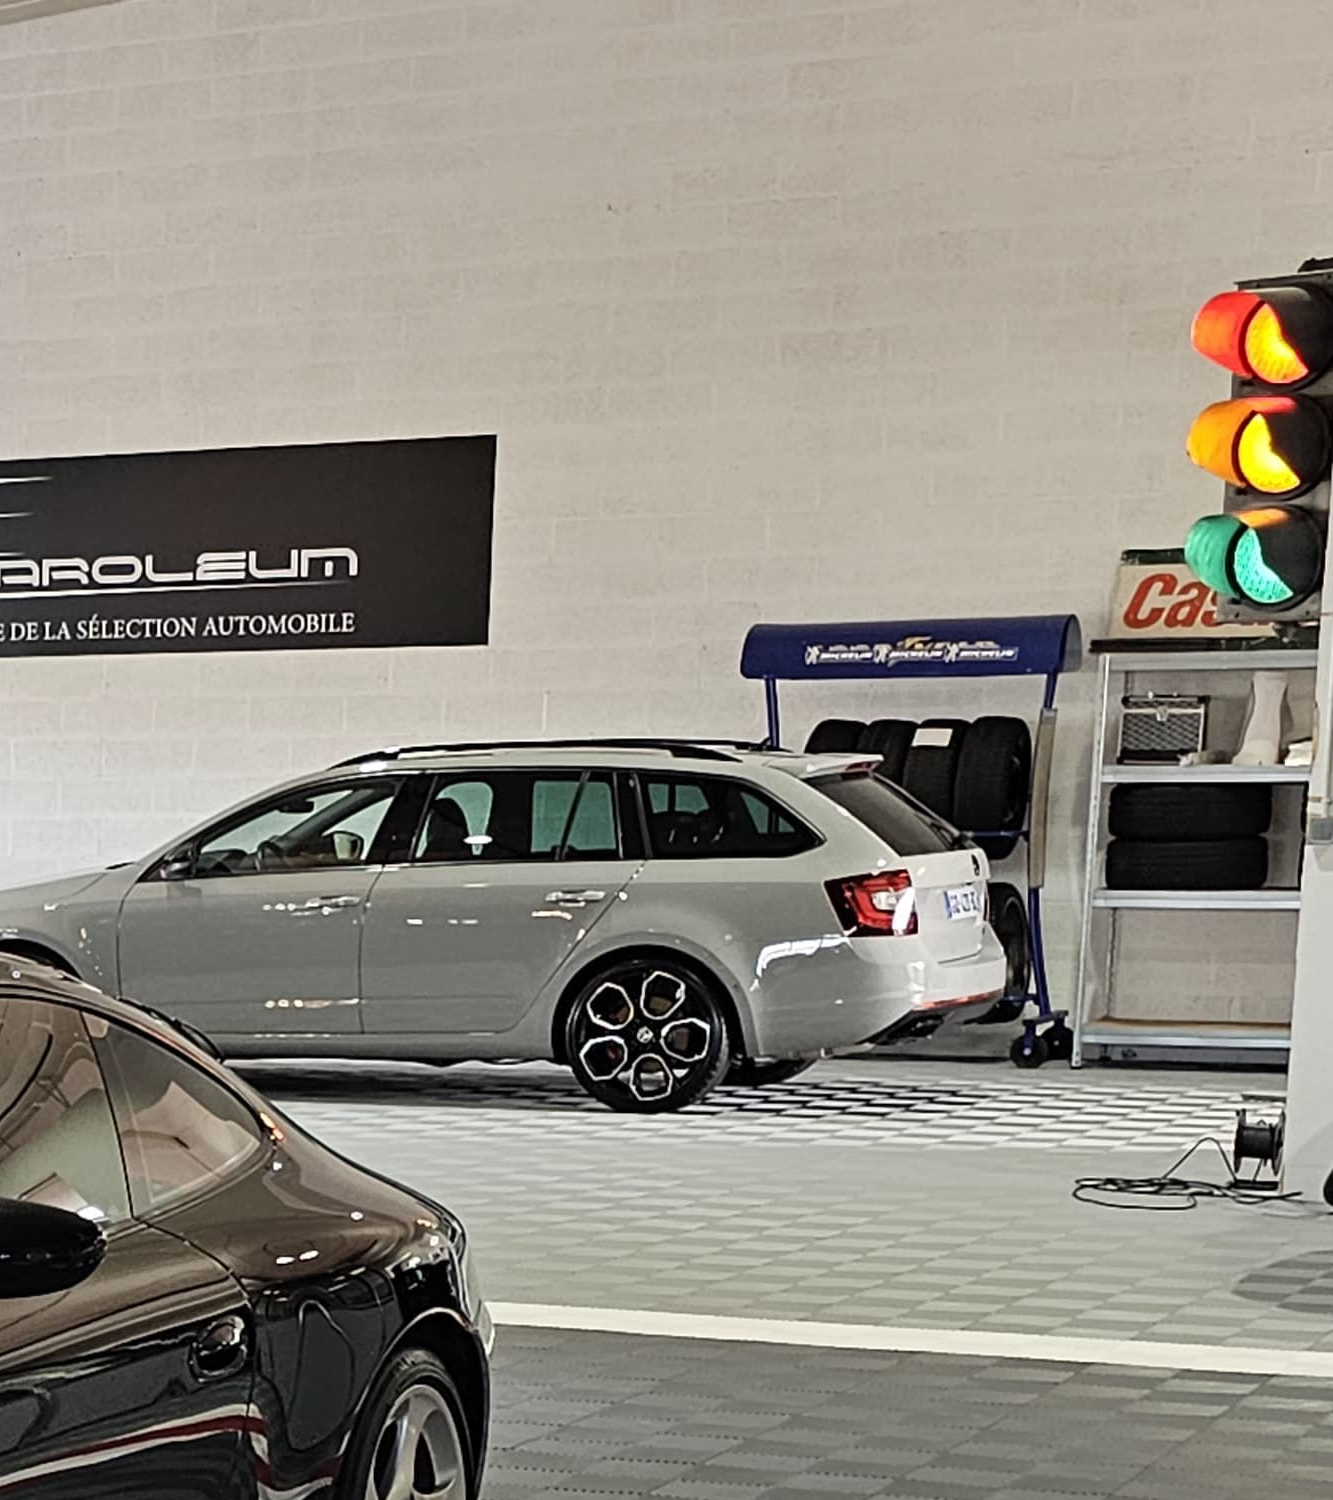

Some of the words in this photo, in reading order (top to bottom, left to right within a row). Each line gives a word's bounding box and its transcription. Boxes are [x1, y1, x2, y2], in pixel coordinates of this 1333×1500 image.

[9, 622, 40, 642] DE
[43, 621, 71, 641] LA
[76, 613, 198, 640] SÉLECTION
[201, 612, 357, 637] AUTOMOBILE
